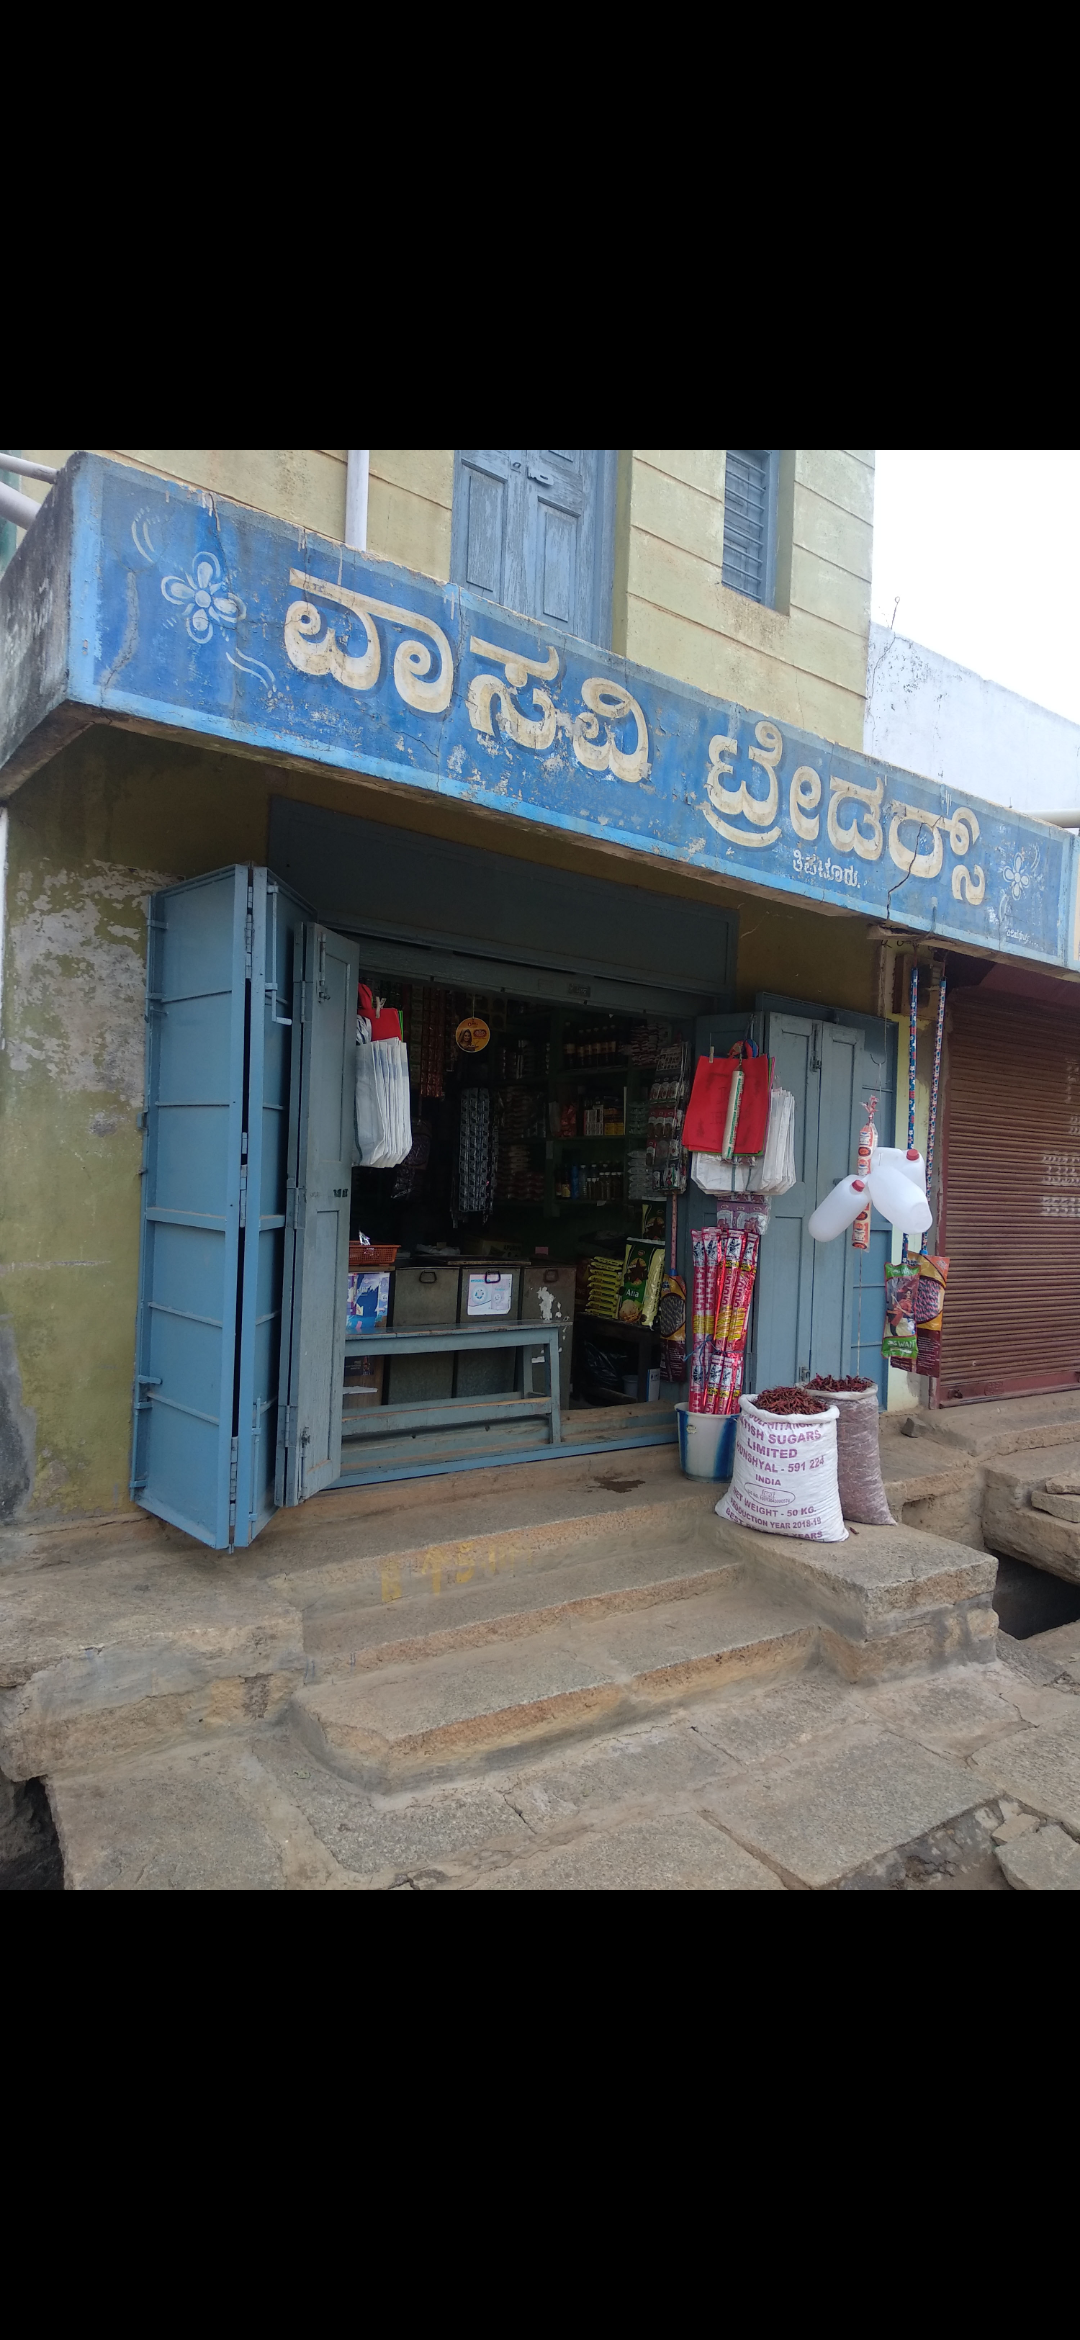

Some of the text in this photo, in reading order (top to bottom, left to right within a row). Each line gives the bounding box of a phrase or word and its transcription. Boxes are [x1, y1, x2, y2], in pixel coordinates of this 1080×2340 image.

[284, 568, 986, 906] ವಾಸವಿ ಟ್ರೇಡರ್ಸ್
[768, 1429, 822, 1444] SUGARS
[747, 1437, 798, 1459] LIMITED
[787, 1461, 806, 1472] 591
[809, 1455, 825, 1469] 224
[755, 1473, 782, 1486] INDIA
[730, 1497, 768, 1527] PRODUCTION
[769, 1520, 791, 1529] YEAR
[792, 1516, 822, 1529] 2018-19
[744, 1497, 779, 1518] WEIGHT
[786, 1508, 799, 1517] 50
